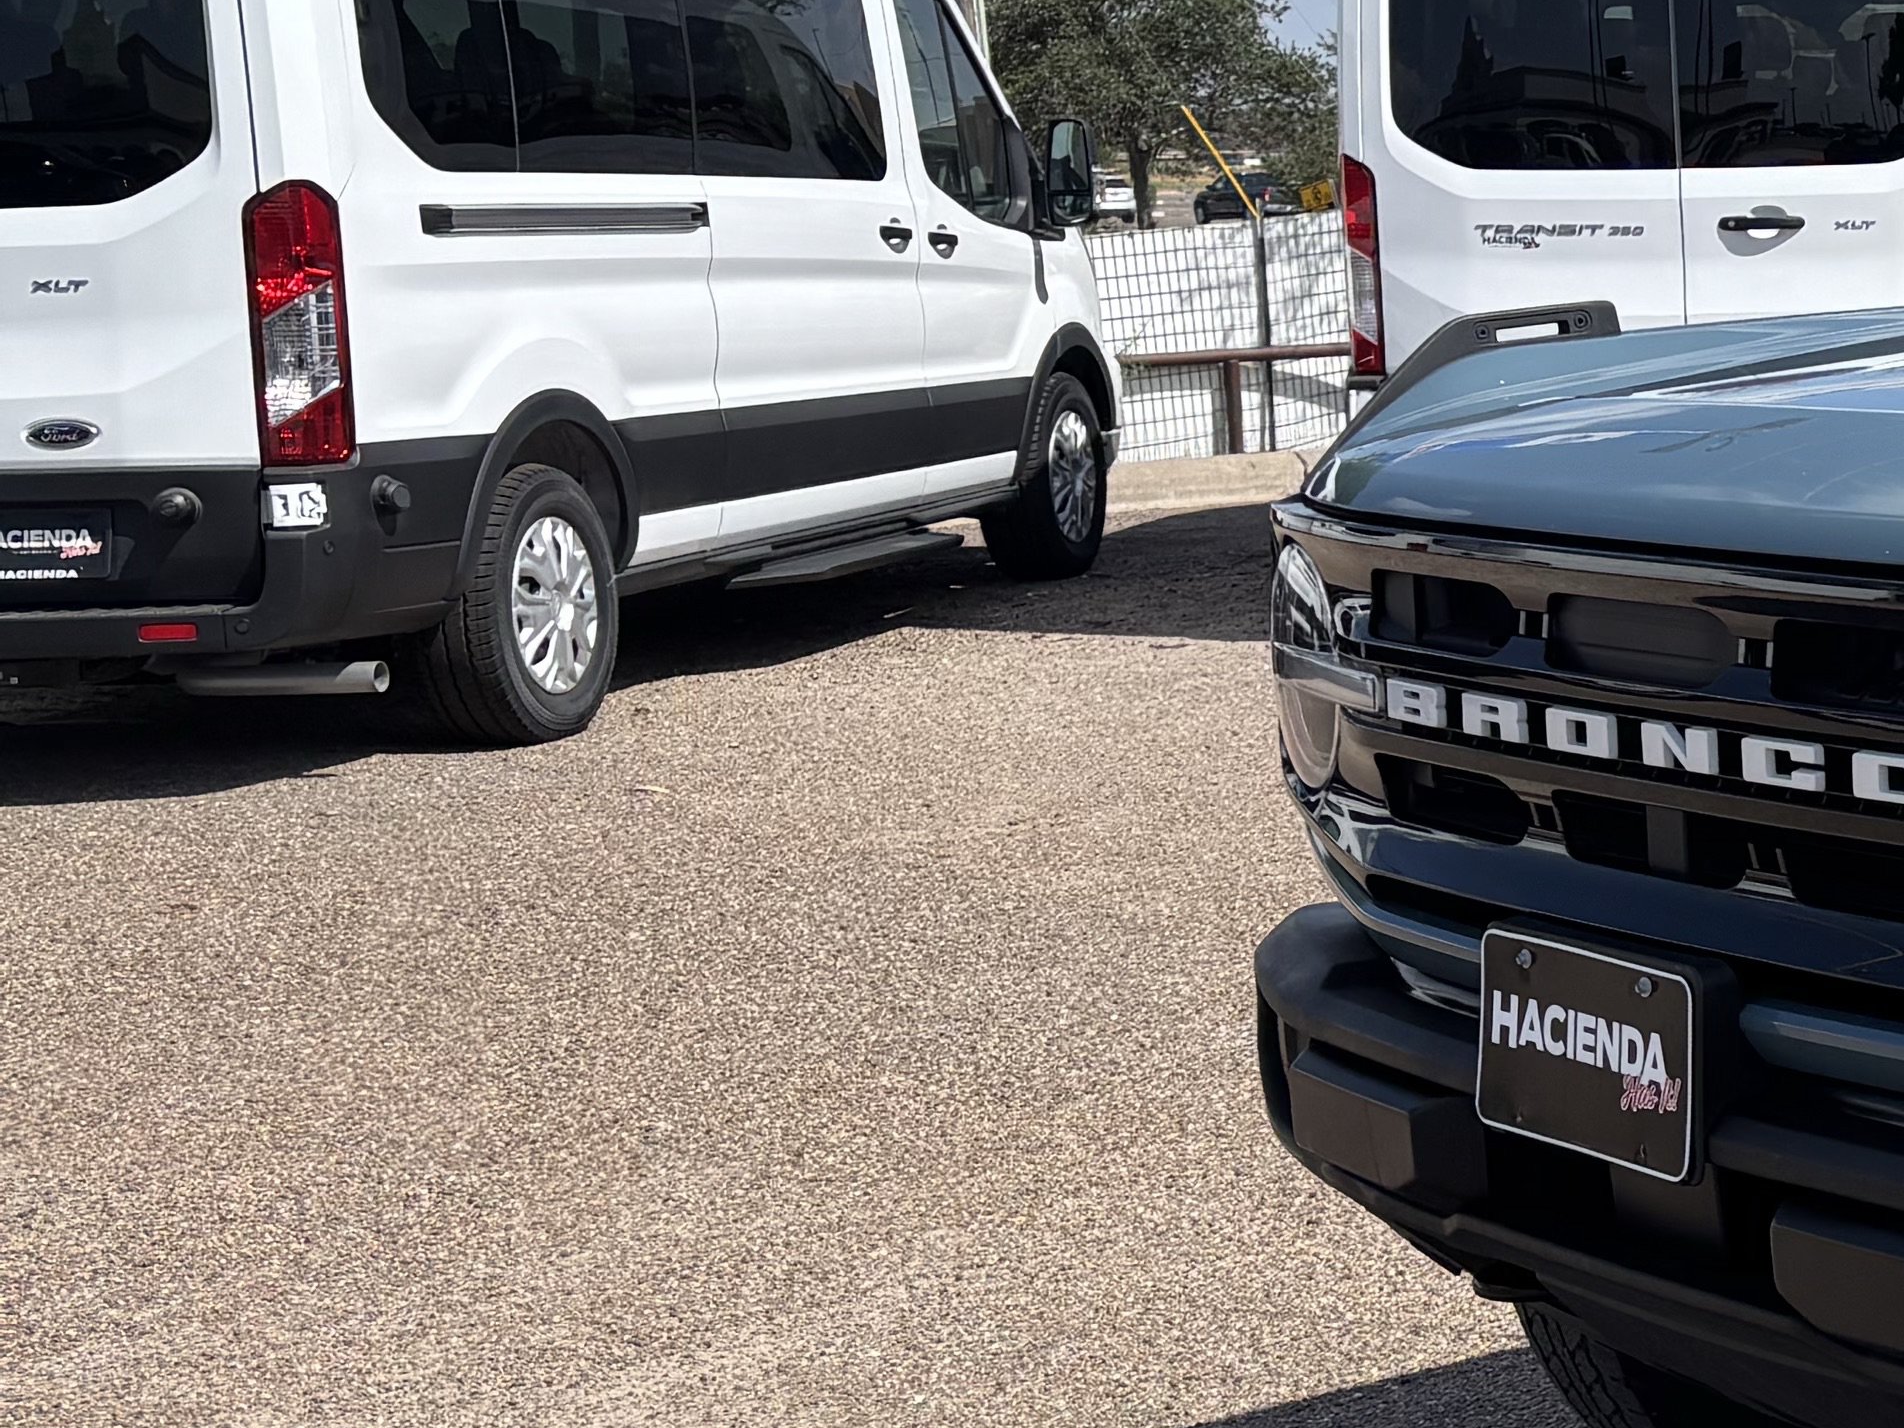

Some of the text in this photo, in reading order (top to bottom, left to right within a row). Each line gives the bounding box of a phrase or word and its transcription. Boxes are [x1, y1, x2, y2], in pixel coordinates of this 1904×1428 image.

[1473, 223, 1605, 237] TRANSIT
[1833, 219, 1877, 231] XLT
[29, 278, 89, 294] XLT
[39, 425, 81, 443] Ford
[1491, 989, 1669, 1090] HACIENDA
[1619, 1073, 1659, 1112] Has
